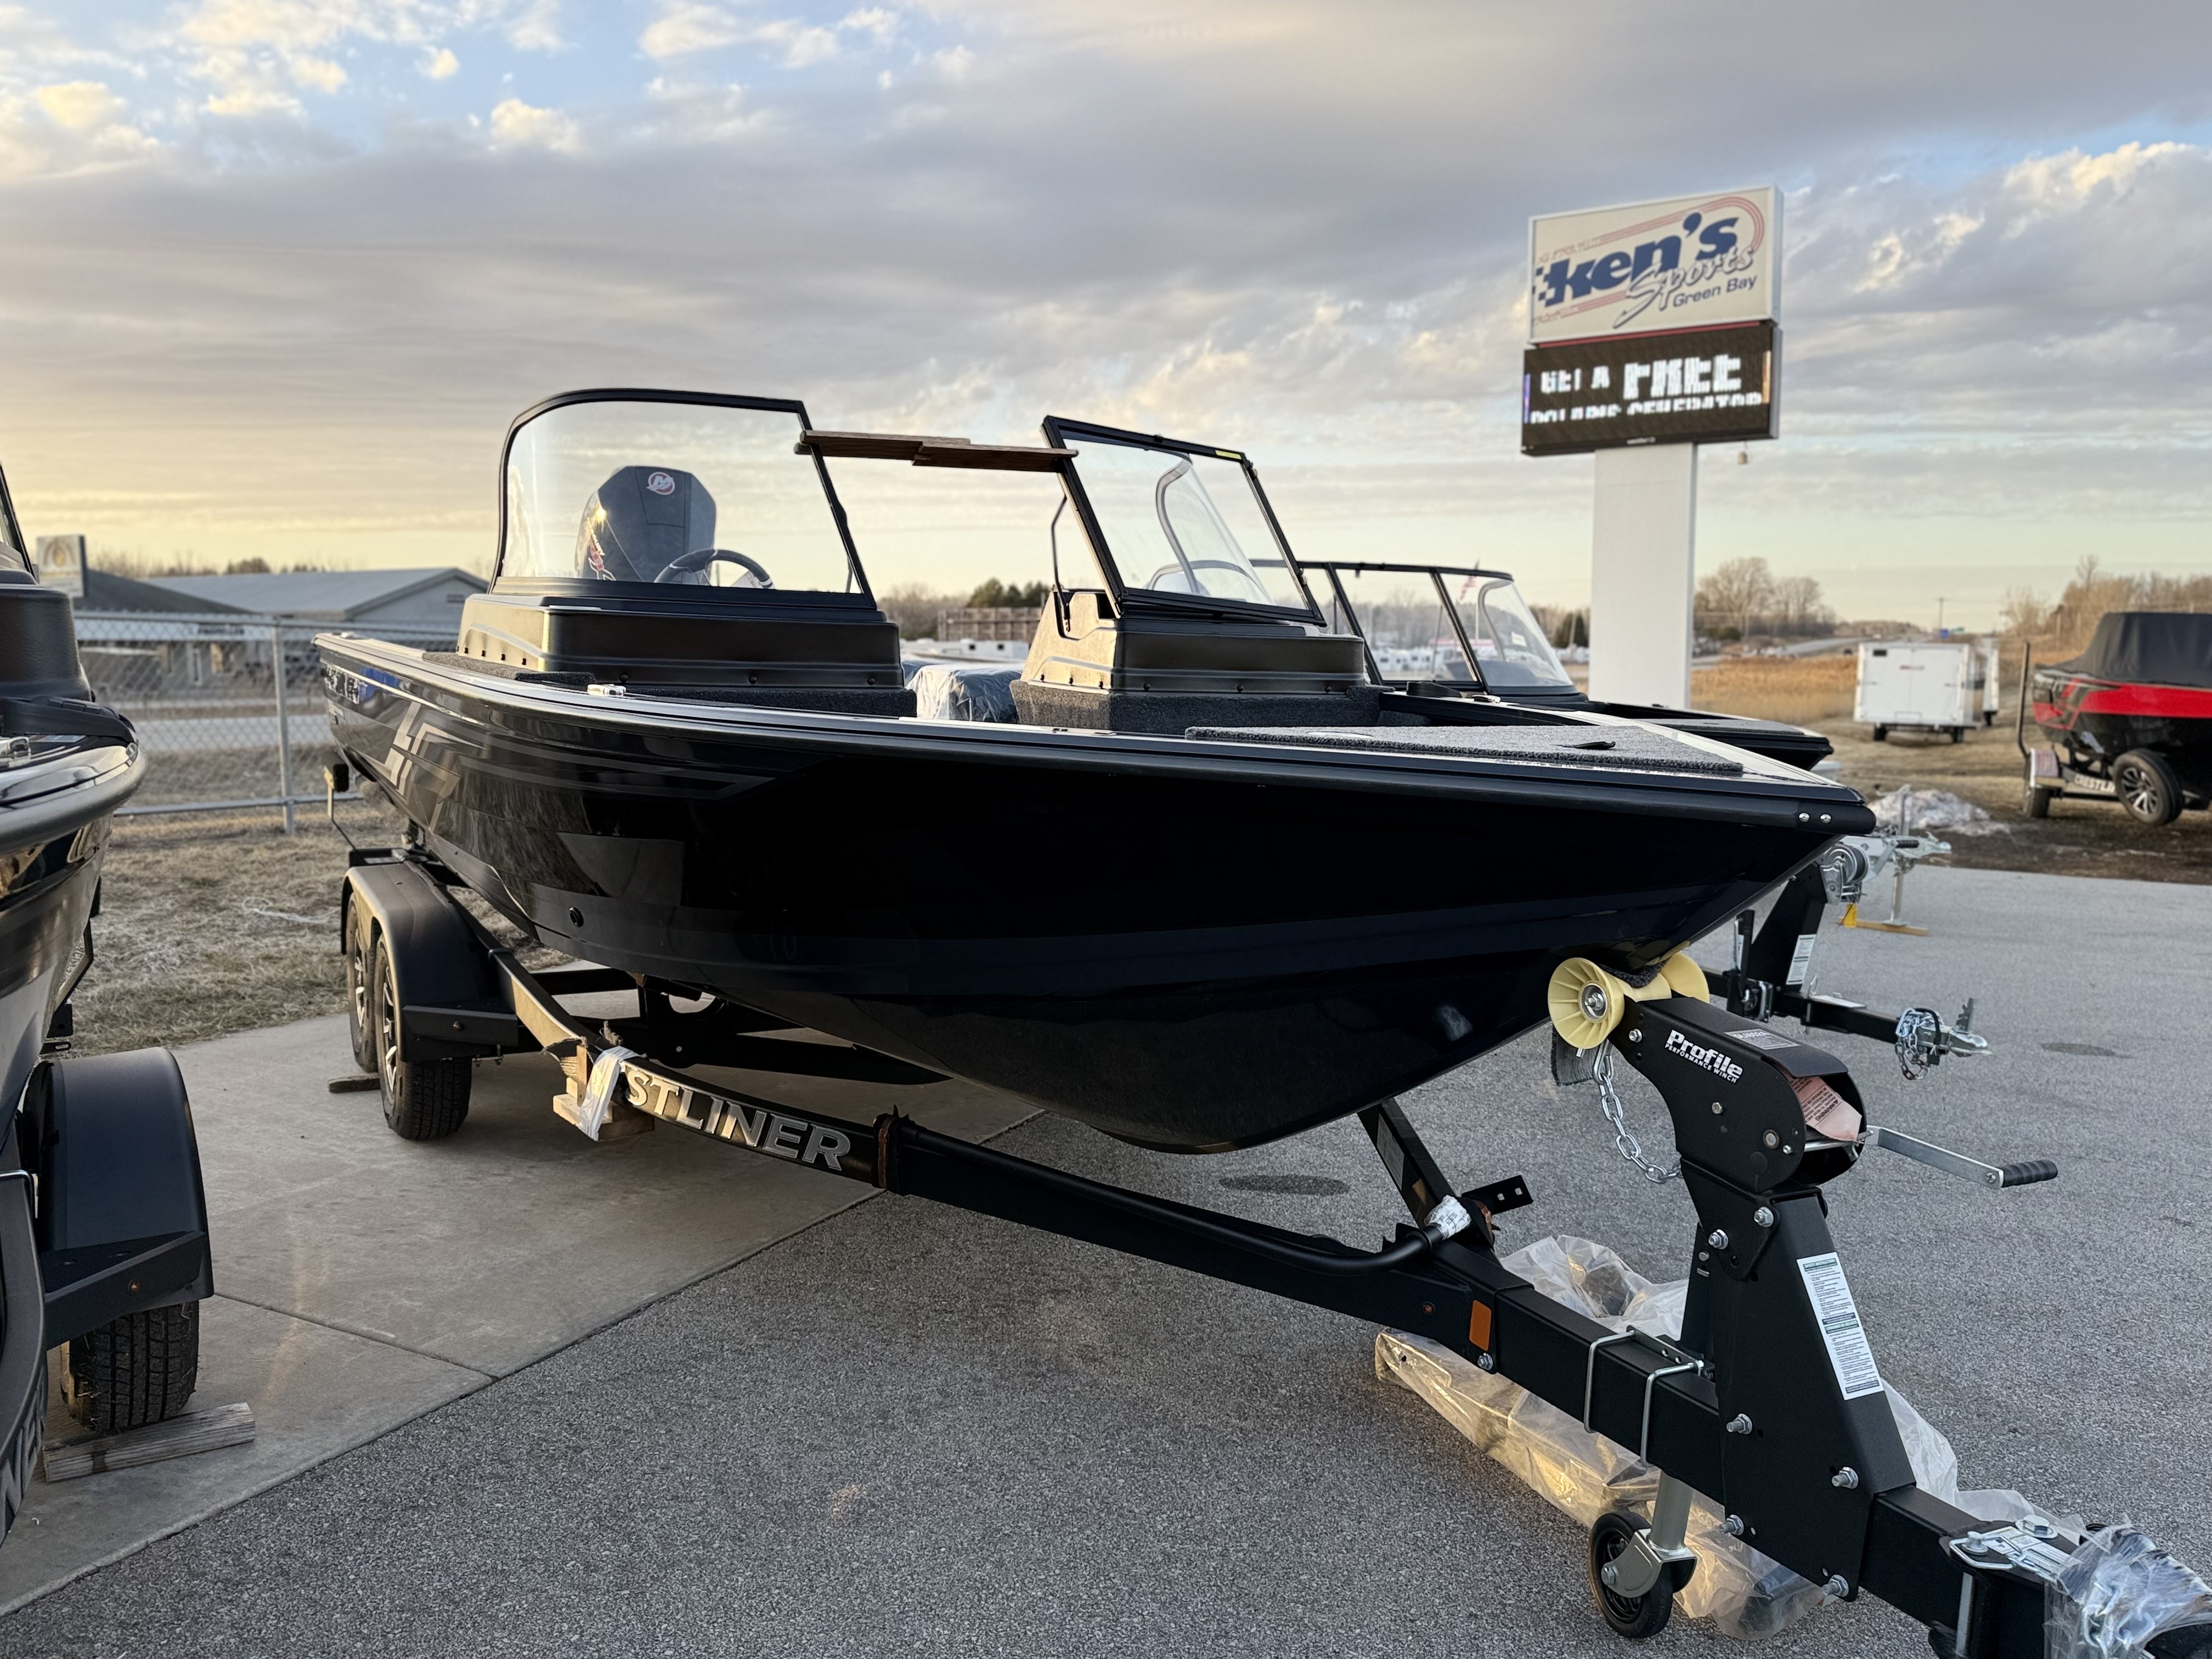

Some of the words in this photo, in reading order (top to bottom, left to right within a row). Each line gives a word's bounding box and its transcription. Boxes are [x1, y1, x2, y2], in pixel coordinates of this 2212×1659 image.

[1543, 212, 1739, 307] ken's
[1613, 245, 1756, 329] Sports
[1673, 285, 1721, 308] Green
[1726, 275, 1757, 293] Bay
[1590, 366, 1610, 389] A
[1664, 1043, 1712, 1070] PERFORMANCE
[1713, 1068, 1737, 1084] WINCH
[1667, 1029, 1743, 1079] Profile
[620, 1062, 851, 1171] STLINER
[1814, 1102, 1836, 1121] WARNING
